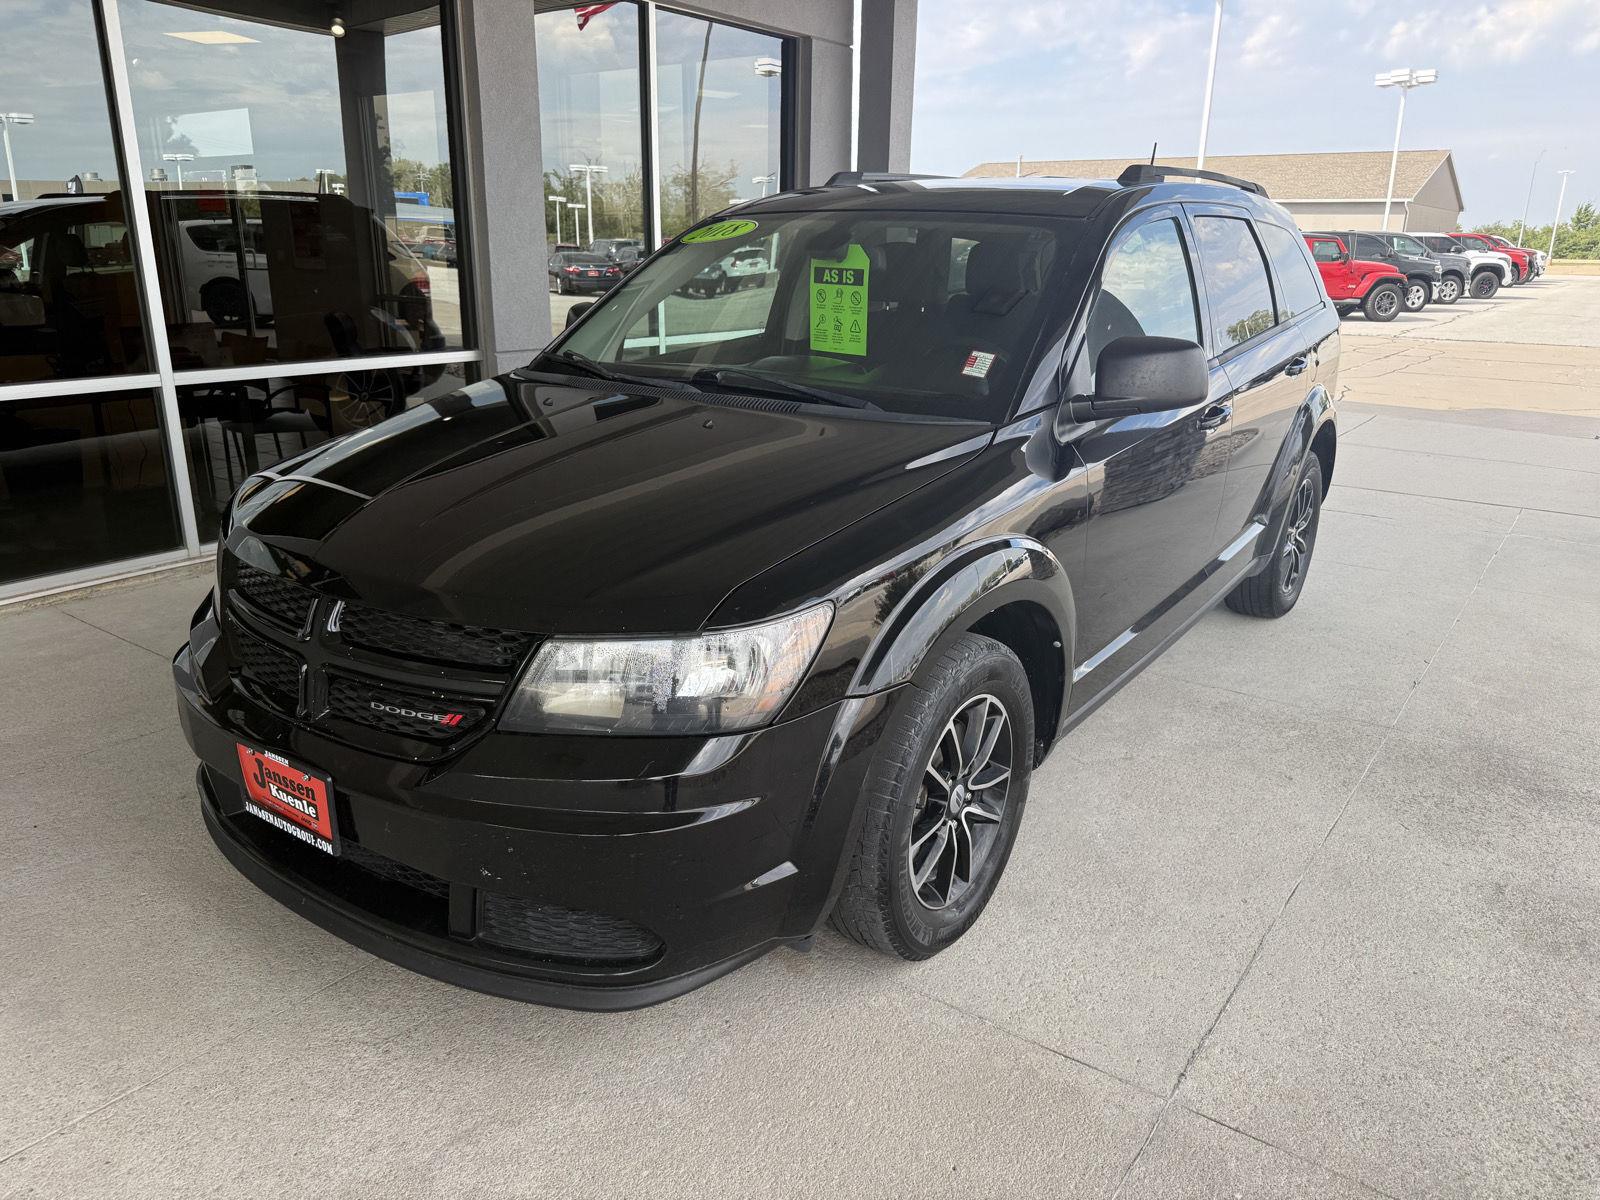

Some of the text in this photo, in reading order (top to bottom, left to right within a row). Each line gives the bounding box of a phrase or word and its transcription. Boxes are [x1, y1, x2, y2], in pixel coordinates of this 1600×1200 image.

[823, 269, 854, 284] AS IS
[370, 701, 450, 723] DODGE
[264, 750, 289, 766] JANSSEN
[253, 758, 316, 801] Janssen
[269, 783, 317, 818] Kuenle
